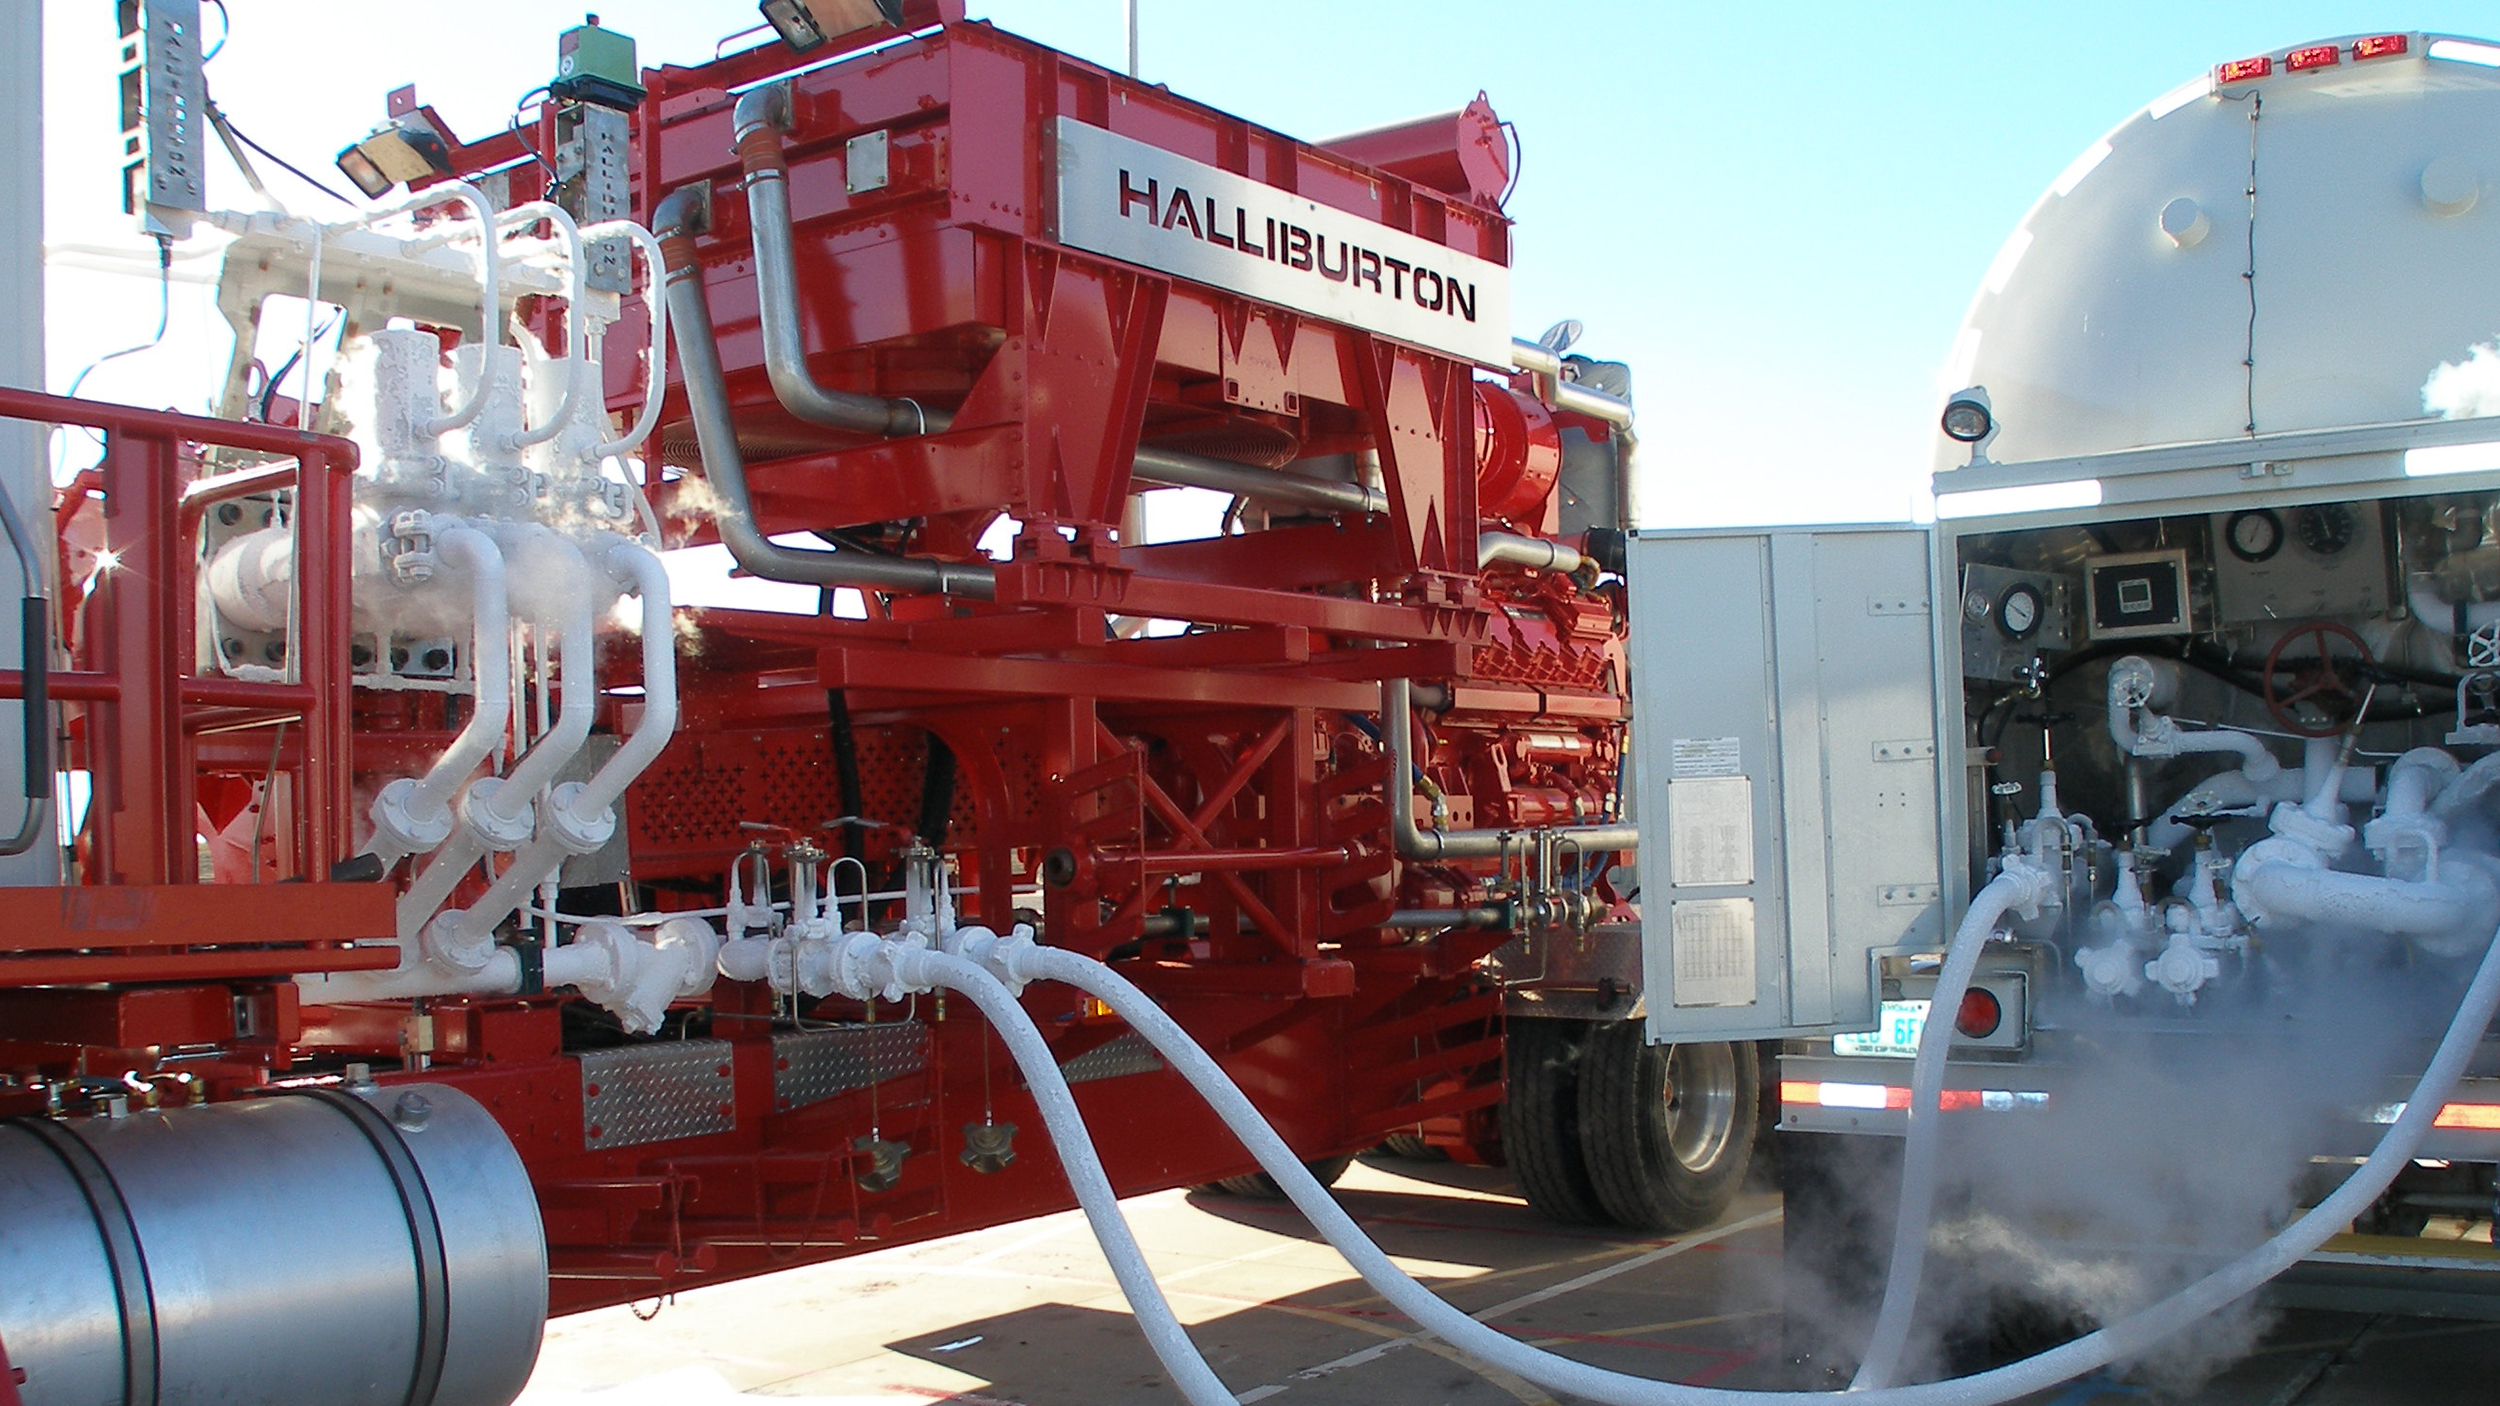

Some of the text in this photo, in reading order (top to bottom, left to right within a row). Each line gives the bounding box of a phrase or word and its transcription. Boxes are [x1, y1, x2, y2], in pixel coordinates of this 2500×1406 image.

[601, 132, 616, 266] HALLIBUON
[1119, 168, 1476, 322] HALLIBURTON
[1894, 1018, 1925, 1045] 6F
